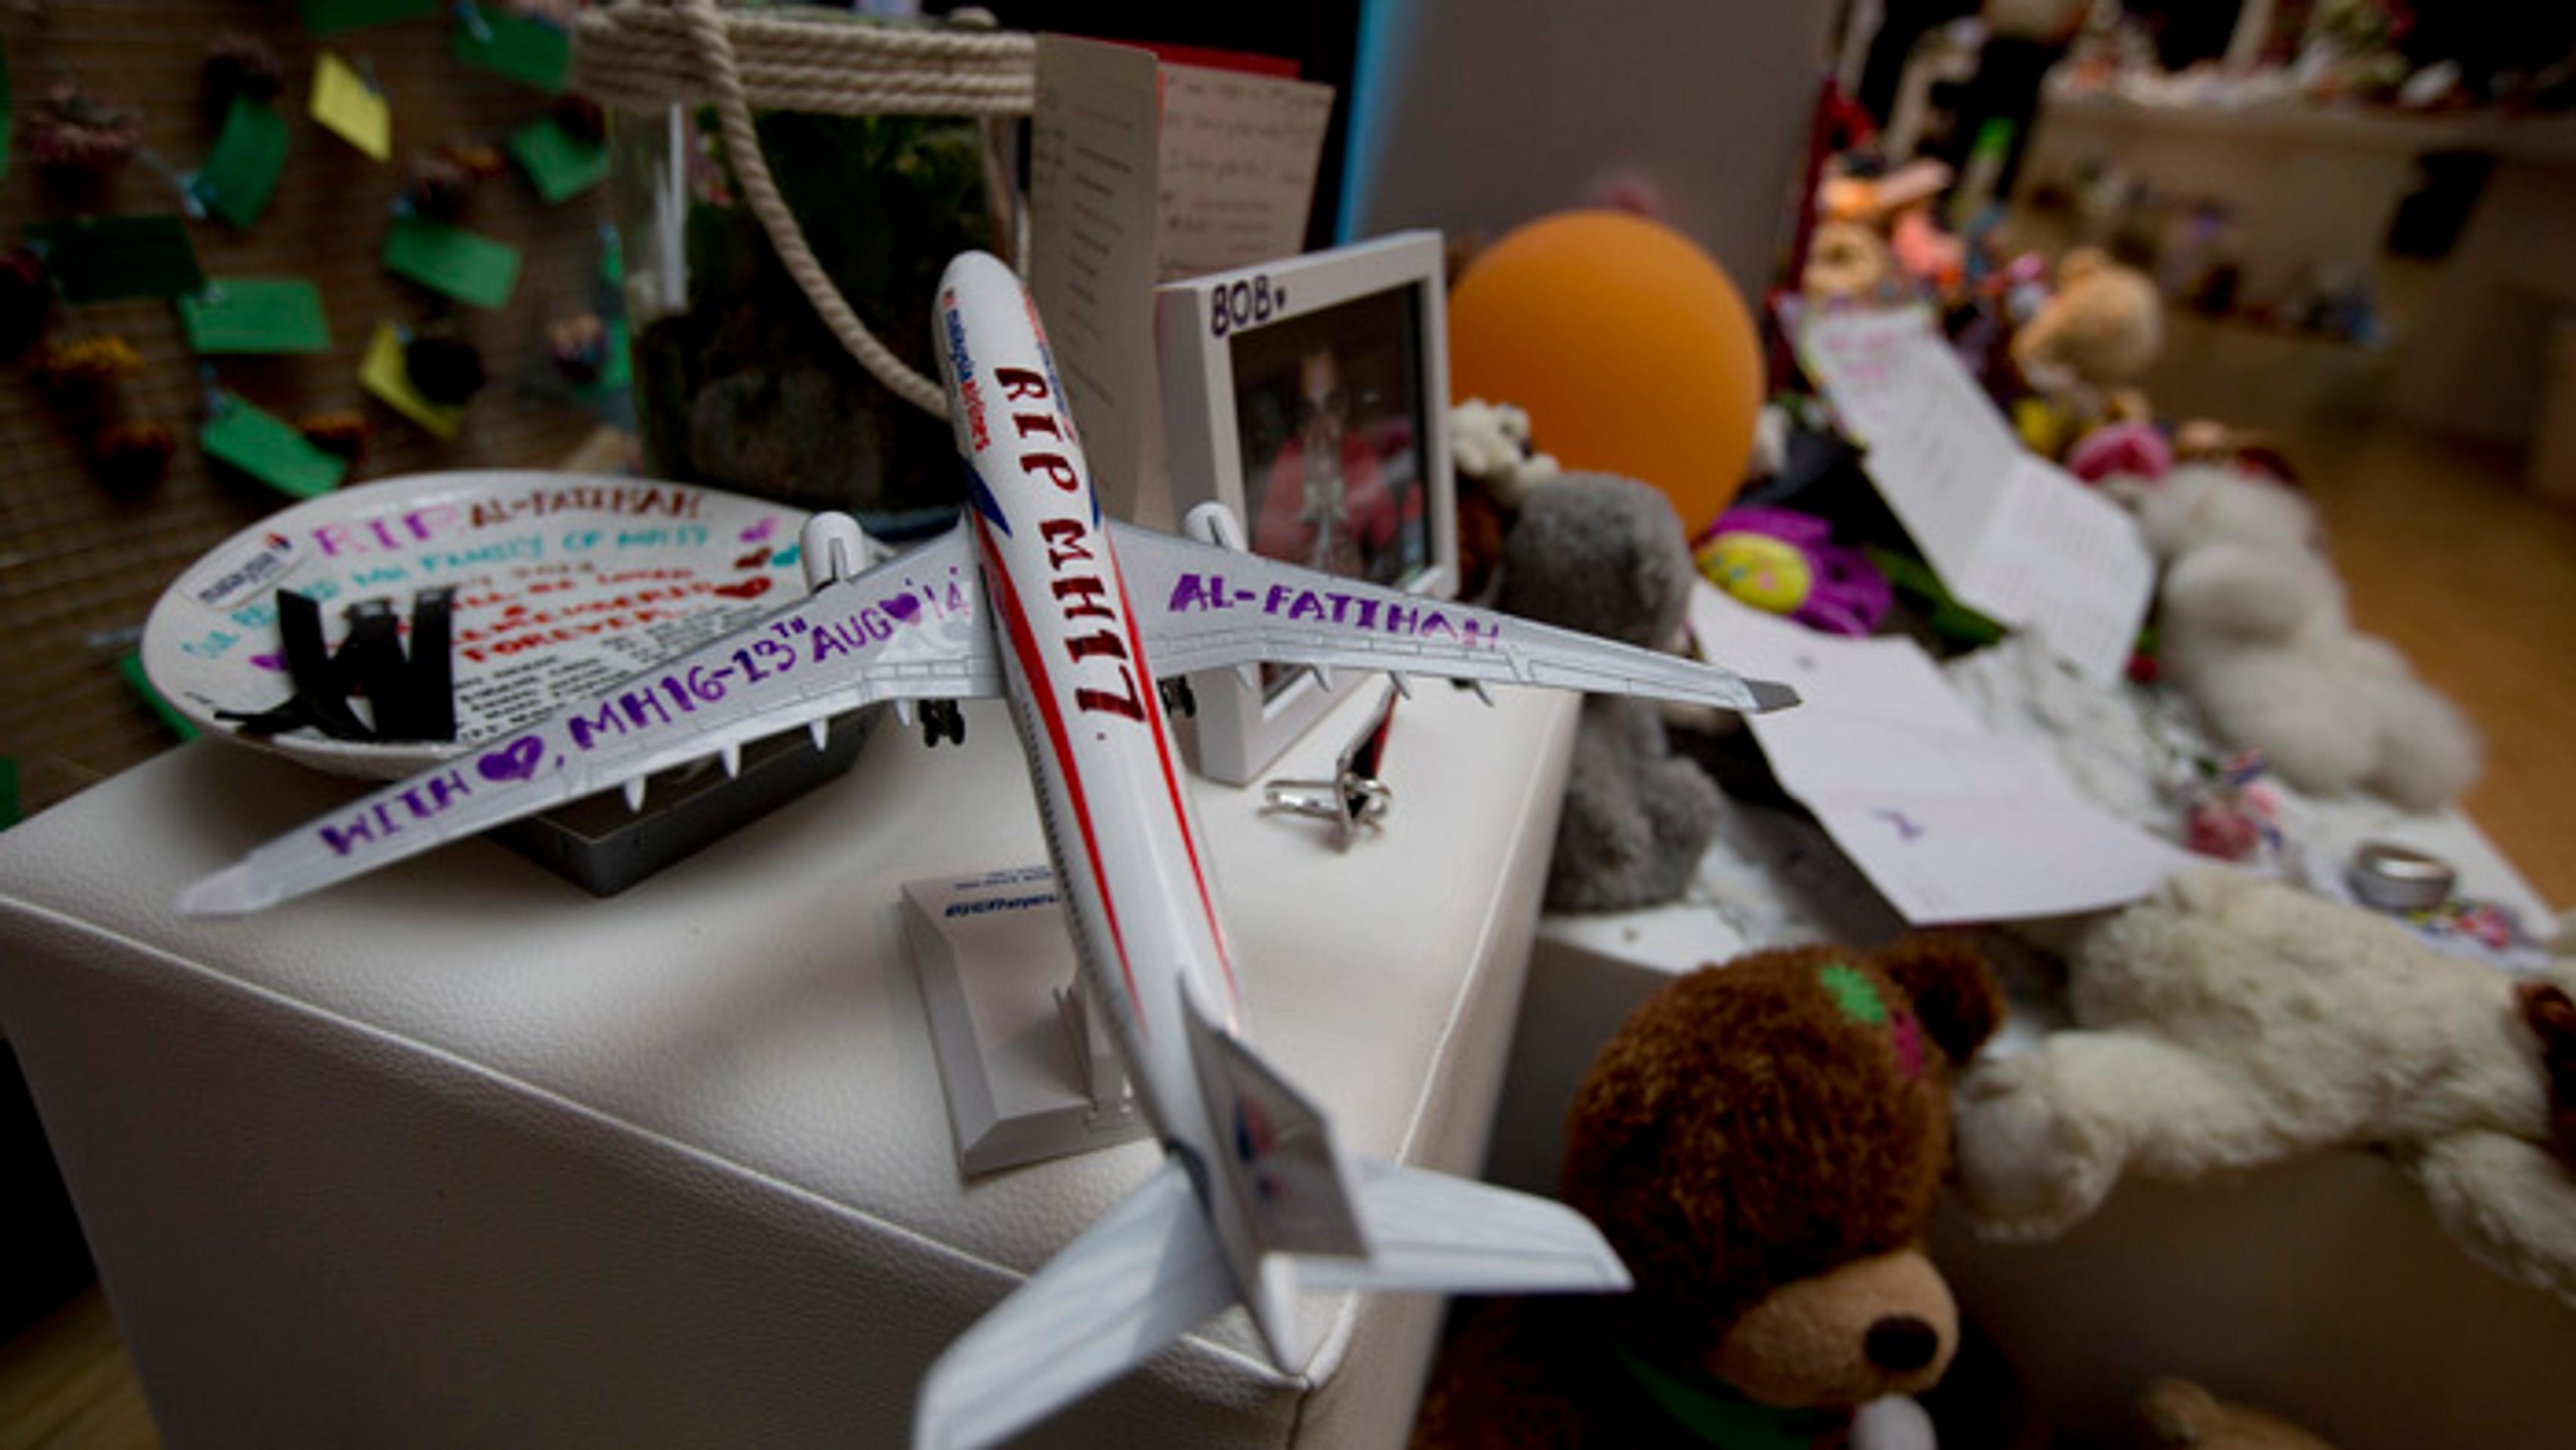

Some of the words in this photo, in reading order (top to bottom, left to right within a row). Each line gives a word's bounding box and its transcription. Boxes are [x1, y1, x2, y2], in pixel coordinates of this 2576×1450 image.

[995, 367, 1080, 495] RIP
[311, 504, 455, 557] RIP
[1168, 573, 1501, 651] AL-FATIHAH
[318, 769, 471, 856] WITH
[810, 606, 894, 663] AUG
